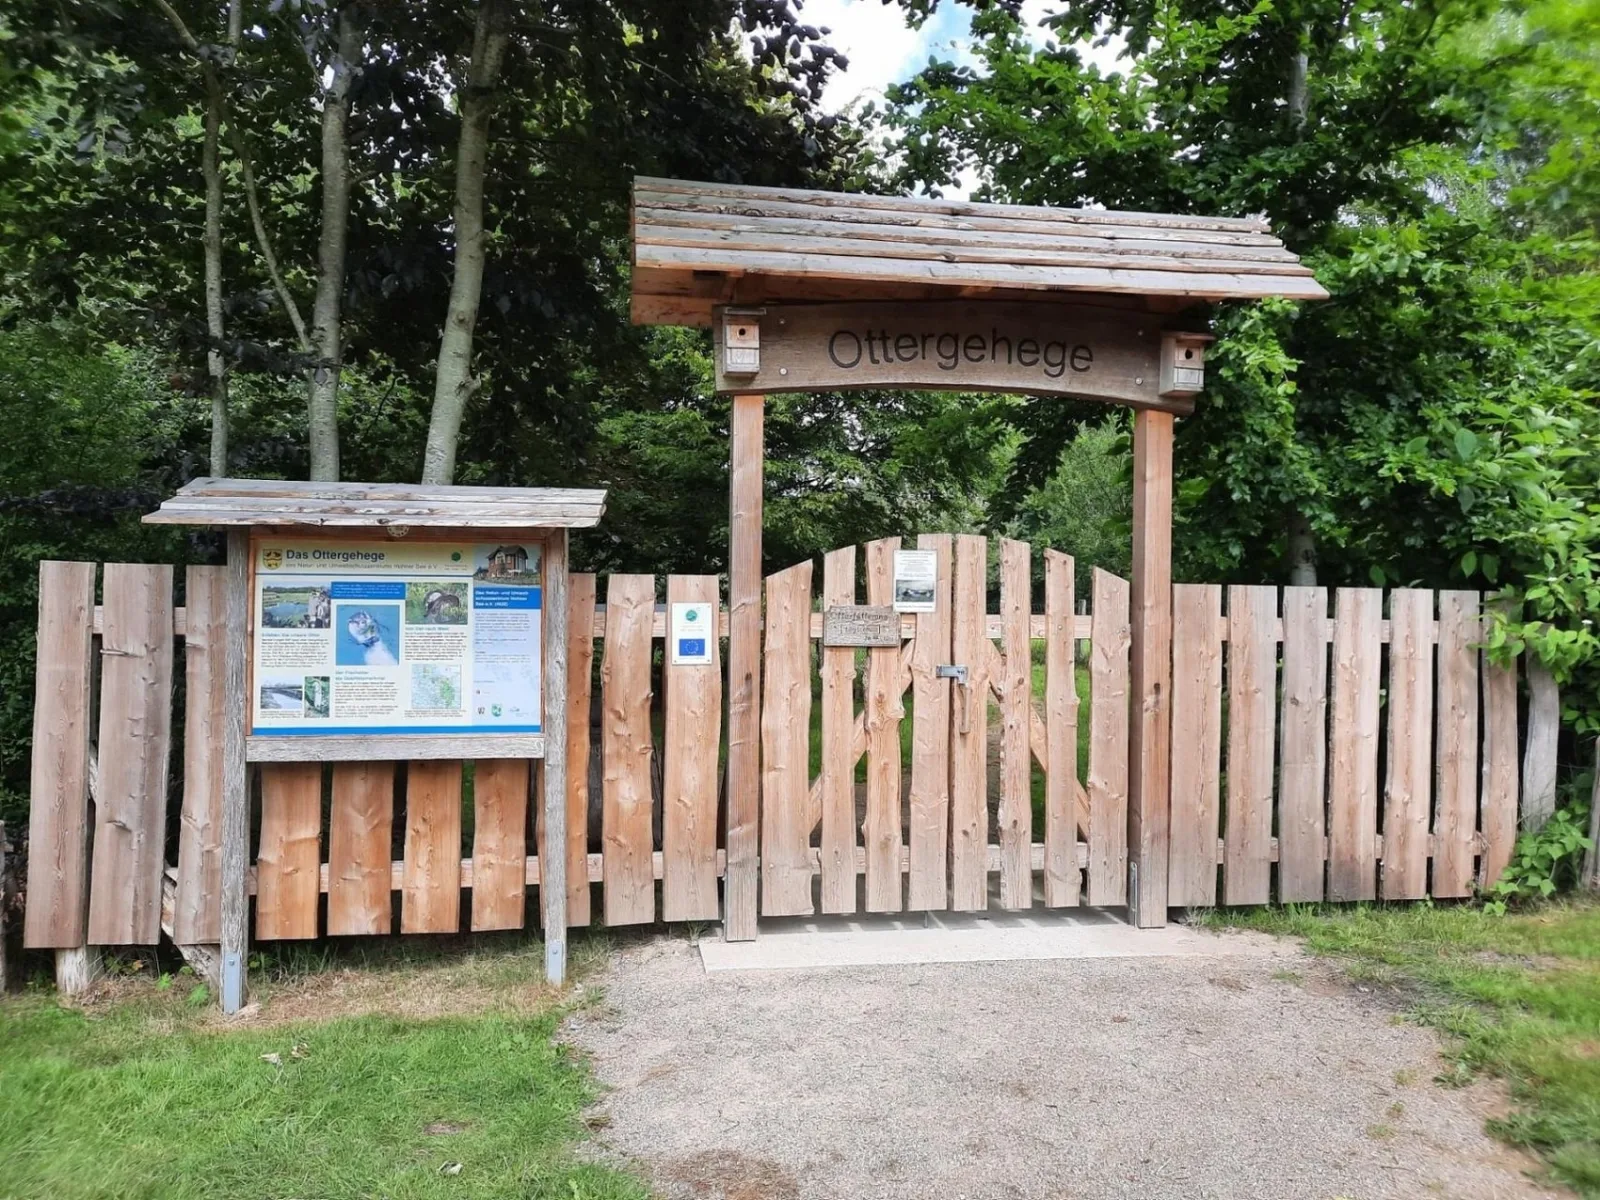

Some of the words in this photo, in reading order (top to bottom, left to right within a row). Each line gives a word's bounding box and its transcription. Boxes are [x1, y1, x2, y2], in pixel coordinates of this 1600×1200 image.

[828, 327, 1094, 378] Ottergehege
[286, 549, 308, 560] Das
[312, 549, 385, 562] Ottergehege
